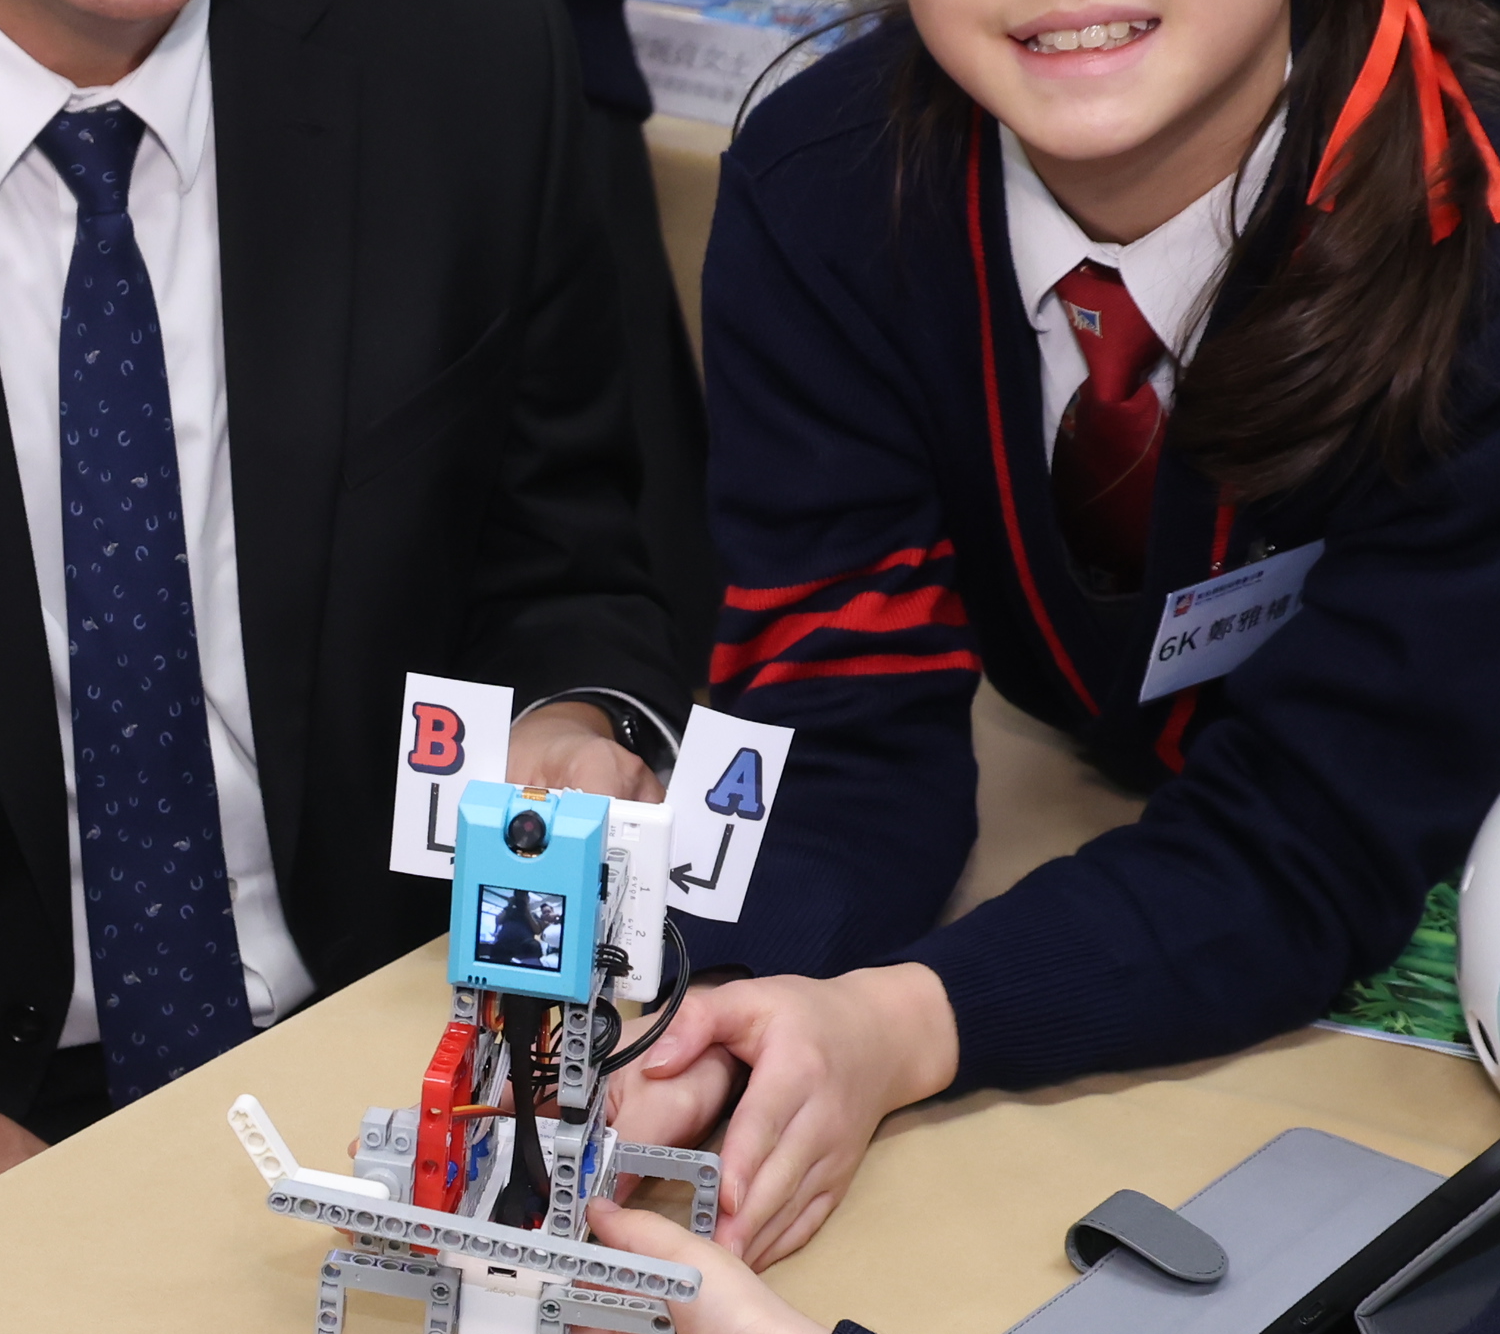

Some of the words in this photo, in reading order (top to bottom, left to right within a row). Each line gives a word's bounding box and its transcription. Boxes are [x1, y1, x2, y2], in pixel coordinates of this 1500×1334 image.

[1158, 626, 1202, 662] 6K
[408, 701, 464, 775] B
[706, 747, 765, 820] A
